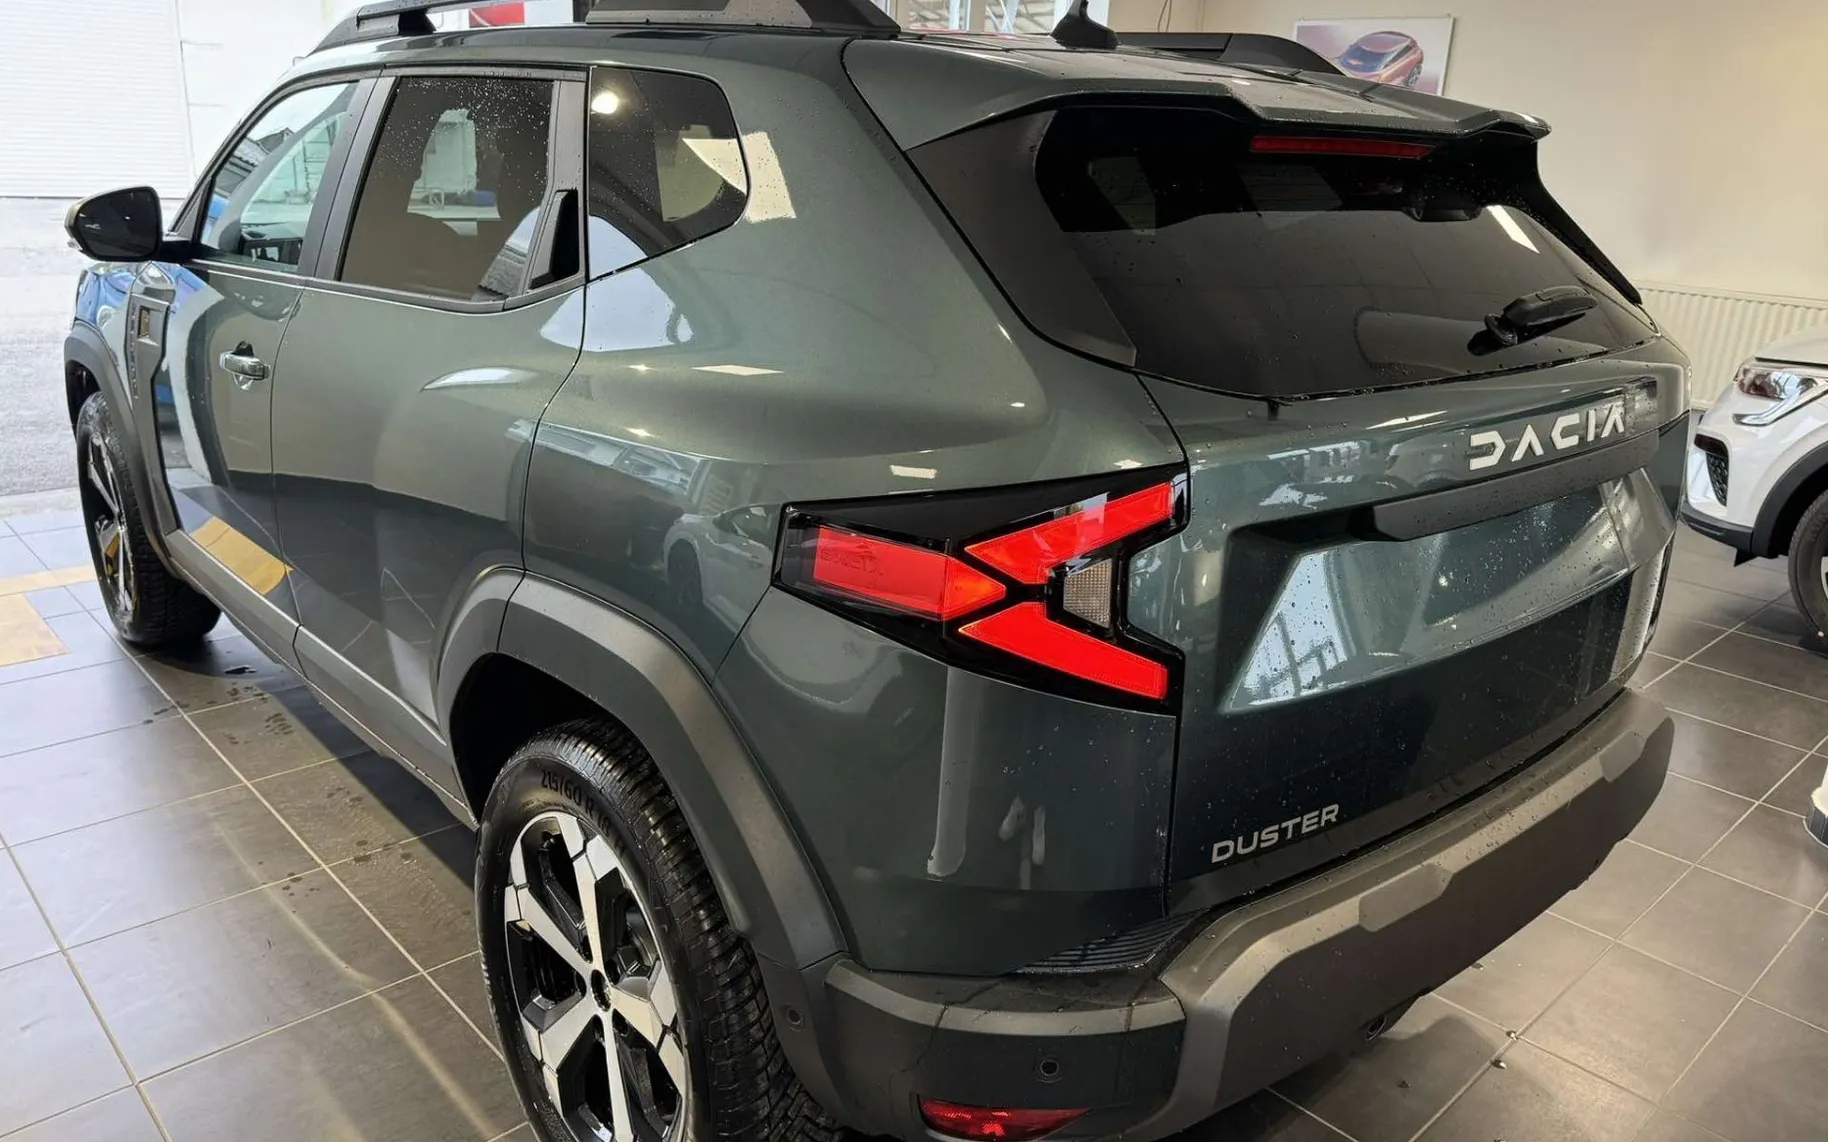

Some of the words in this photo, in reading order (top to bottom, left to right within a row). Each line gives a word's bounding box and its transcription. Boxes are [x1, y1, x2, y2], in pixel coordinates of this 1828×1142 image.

[1469, 404, 1625, 470] DACIA
[541, 769, 582, 806] 215/60
[1211, 803, 1340, 863] DUSTER
